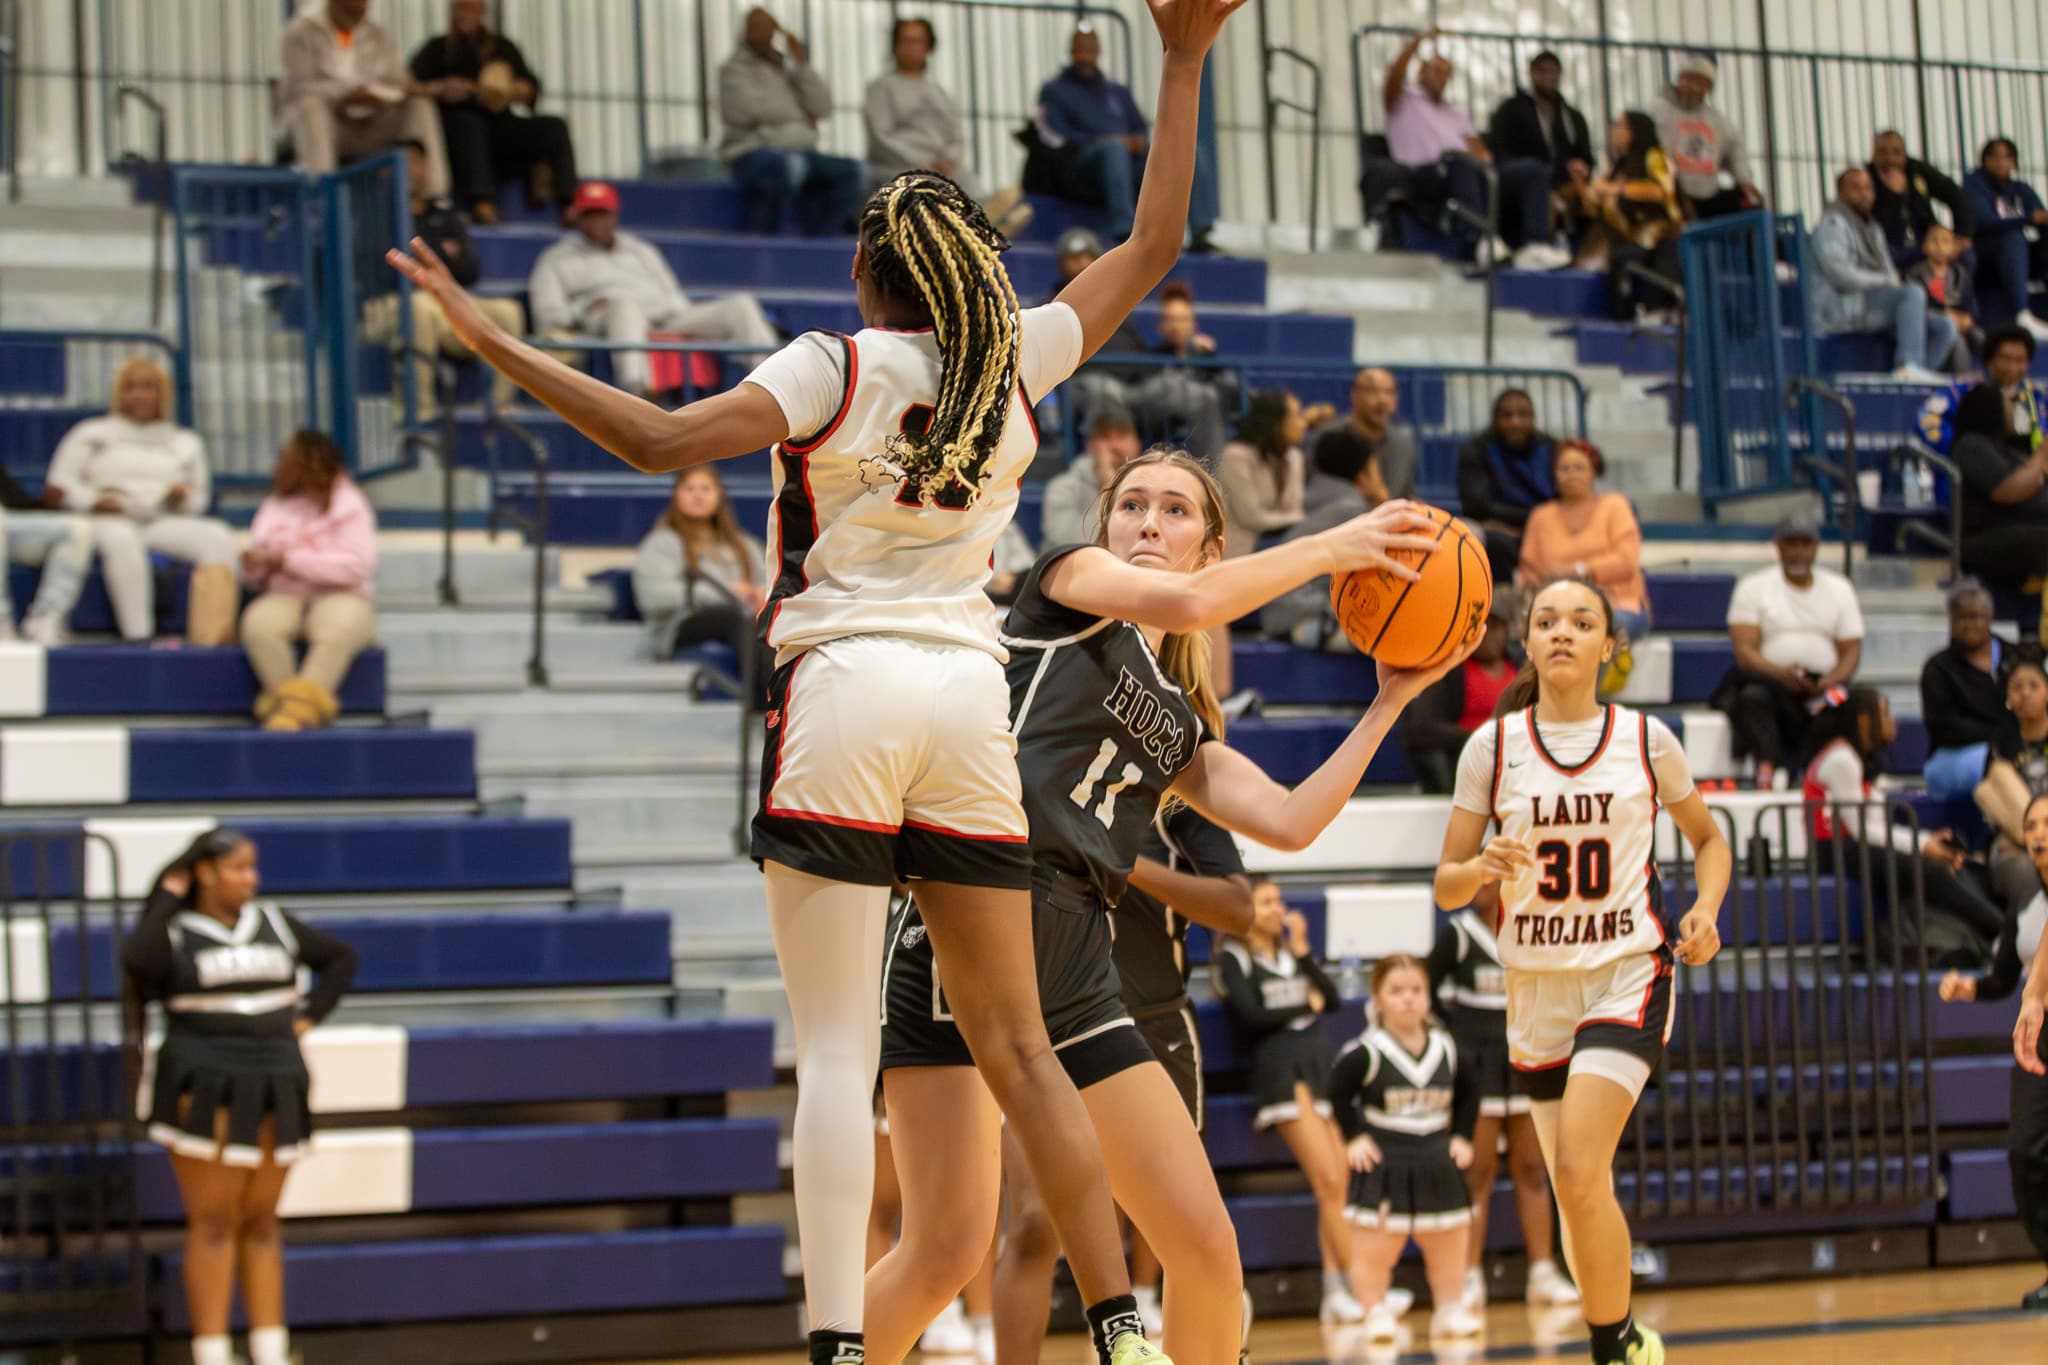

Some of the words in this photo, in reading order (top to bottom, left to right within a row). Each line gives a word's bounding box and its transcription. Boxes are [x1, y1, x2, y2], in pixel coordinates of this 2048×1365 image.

[1069, 737, 1143, 831] 11
[1531, 792, 1614, 828] LADY
[1535, 837, 1612, 904] 30
[1514, 908, 1635, 947] TROJANS
